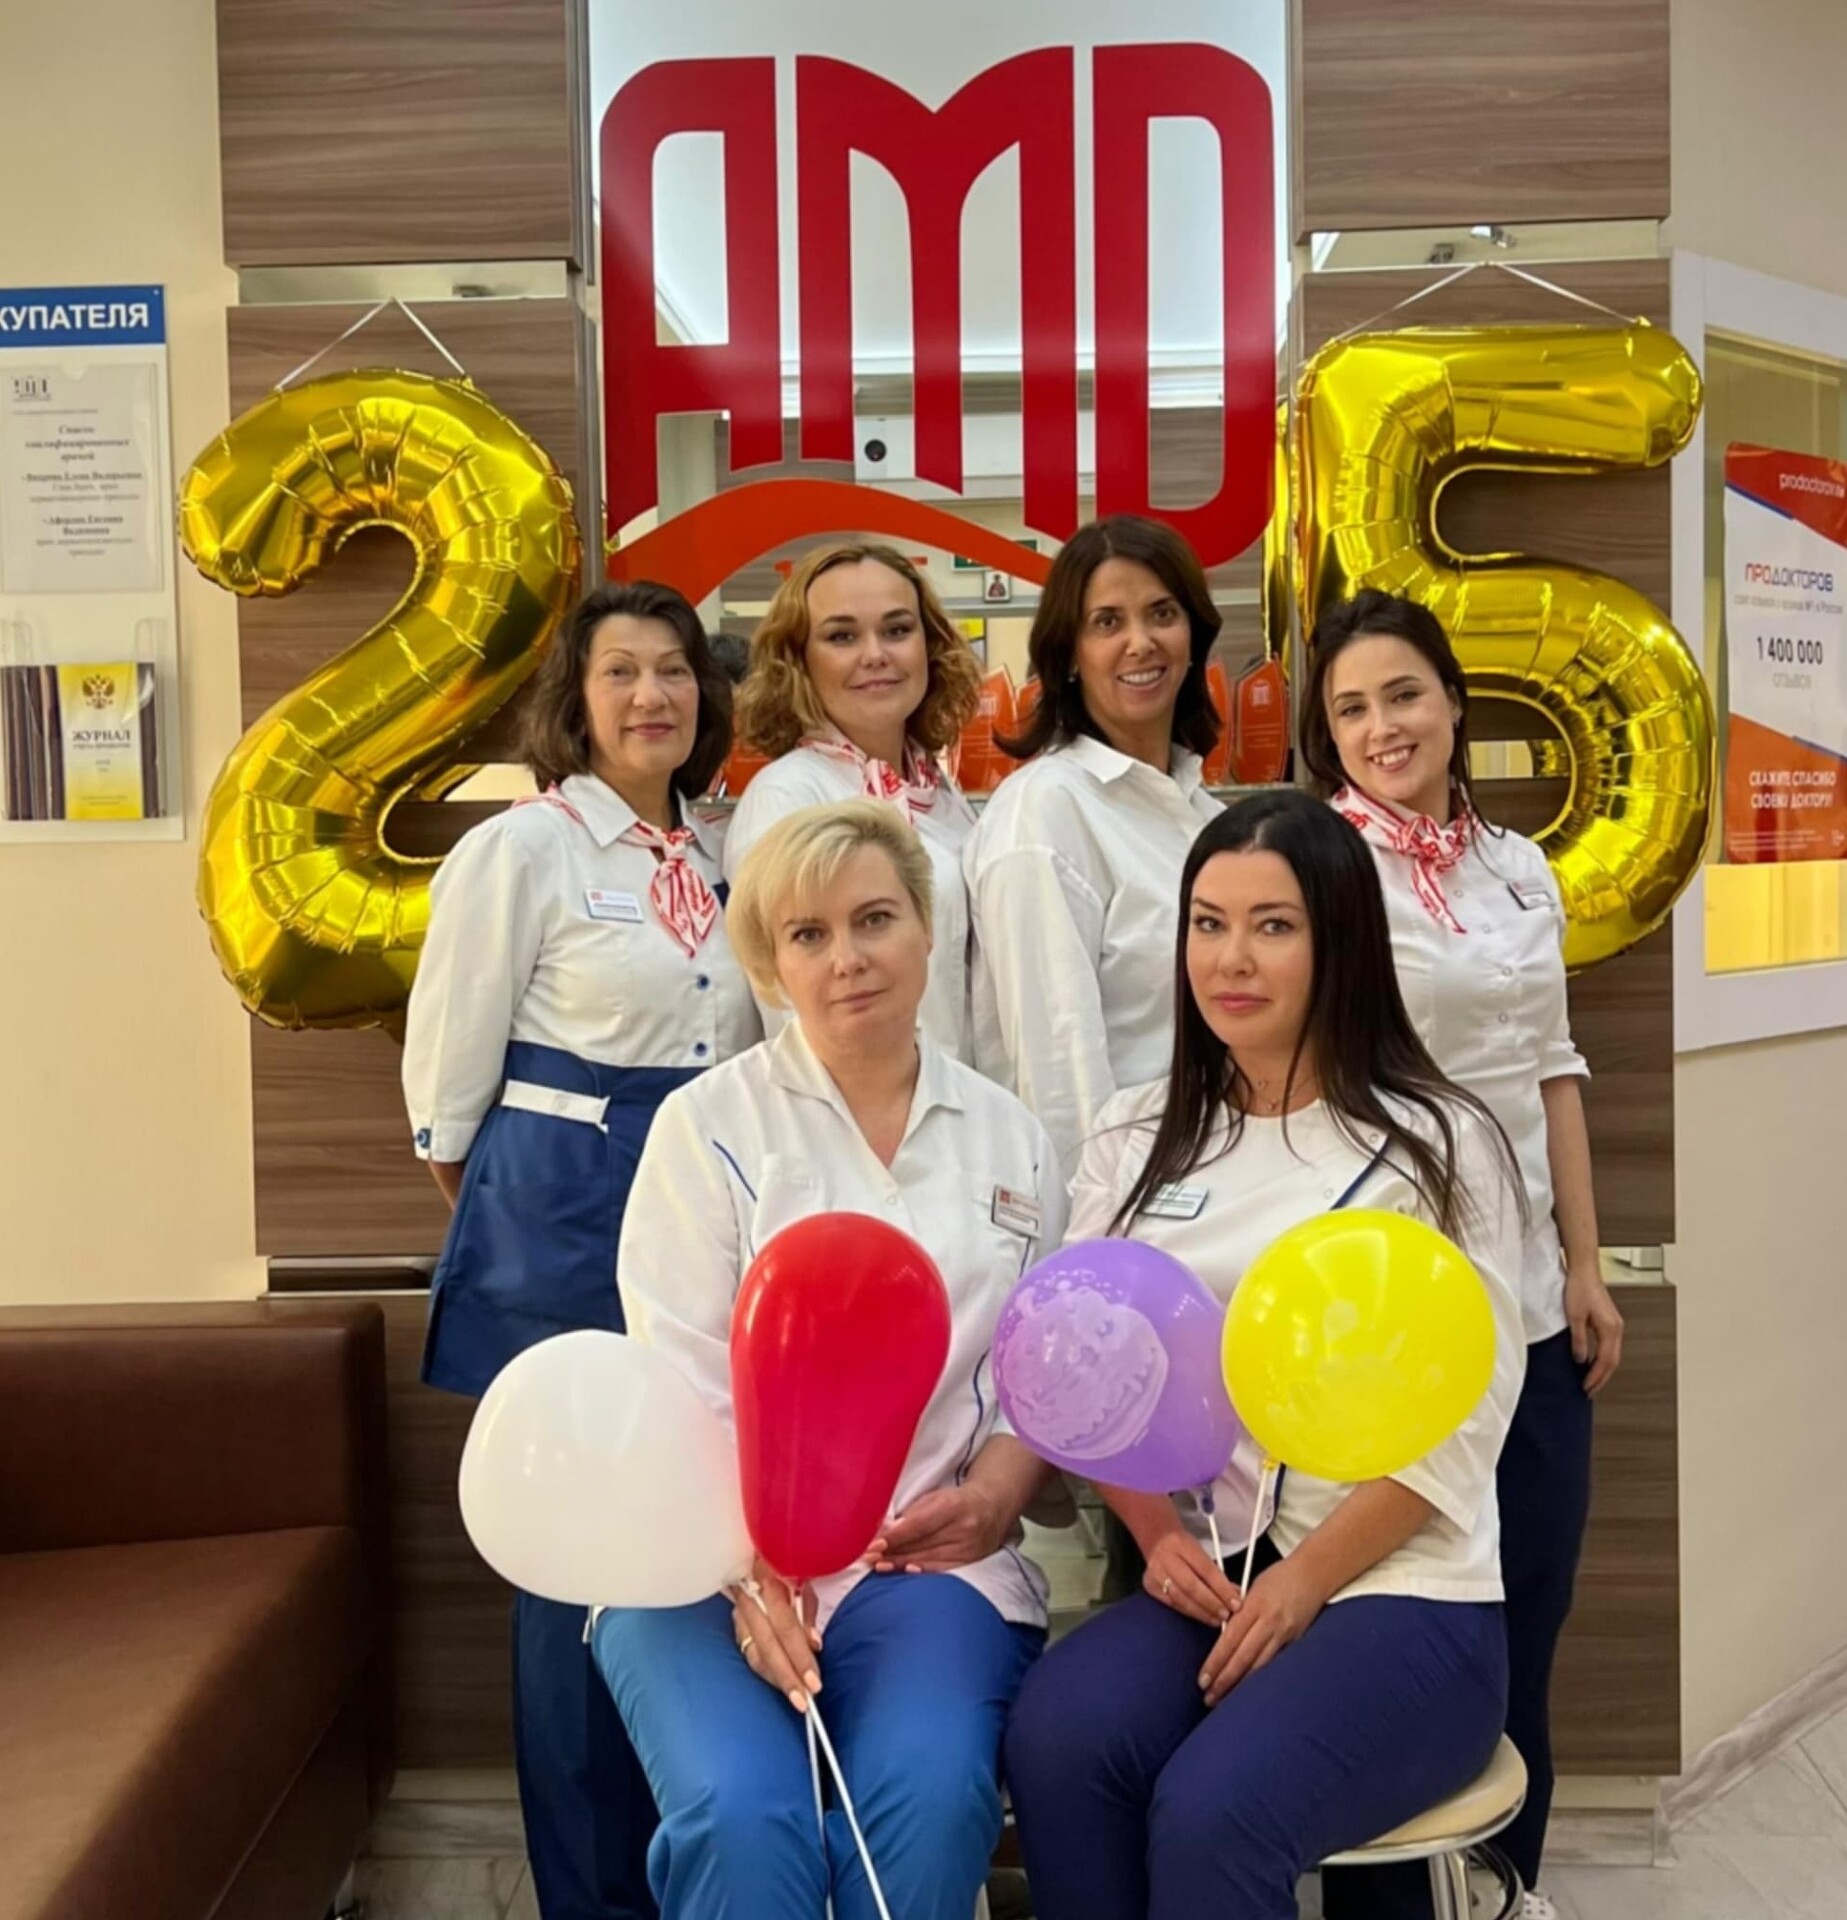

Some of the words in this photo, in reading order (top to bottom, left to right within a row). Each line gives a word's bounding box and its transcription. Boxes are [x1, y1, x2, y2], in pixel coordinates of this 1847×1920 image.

[600, 42, 1276, 570] AMD
[1745, 562, 1834, 593] ПРОДОКТОРОВ
[1757, 636, 1763, 661] 1
[1767, 637, 1793, 663] 400
[1797, 639, 1823, 665] 000
[72, 729, 131, 741] ЖУРНАЛ
